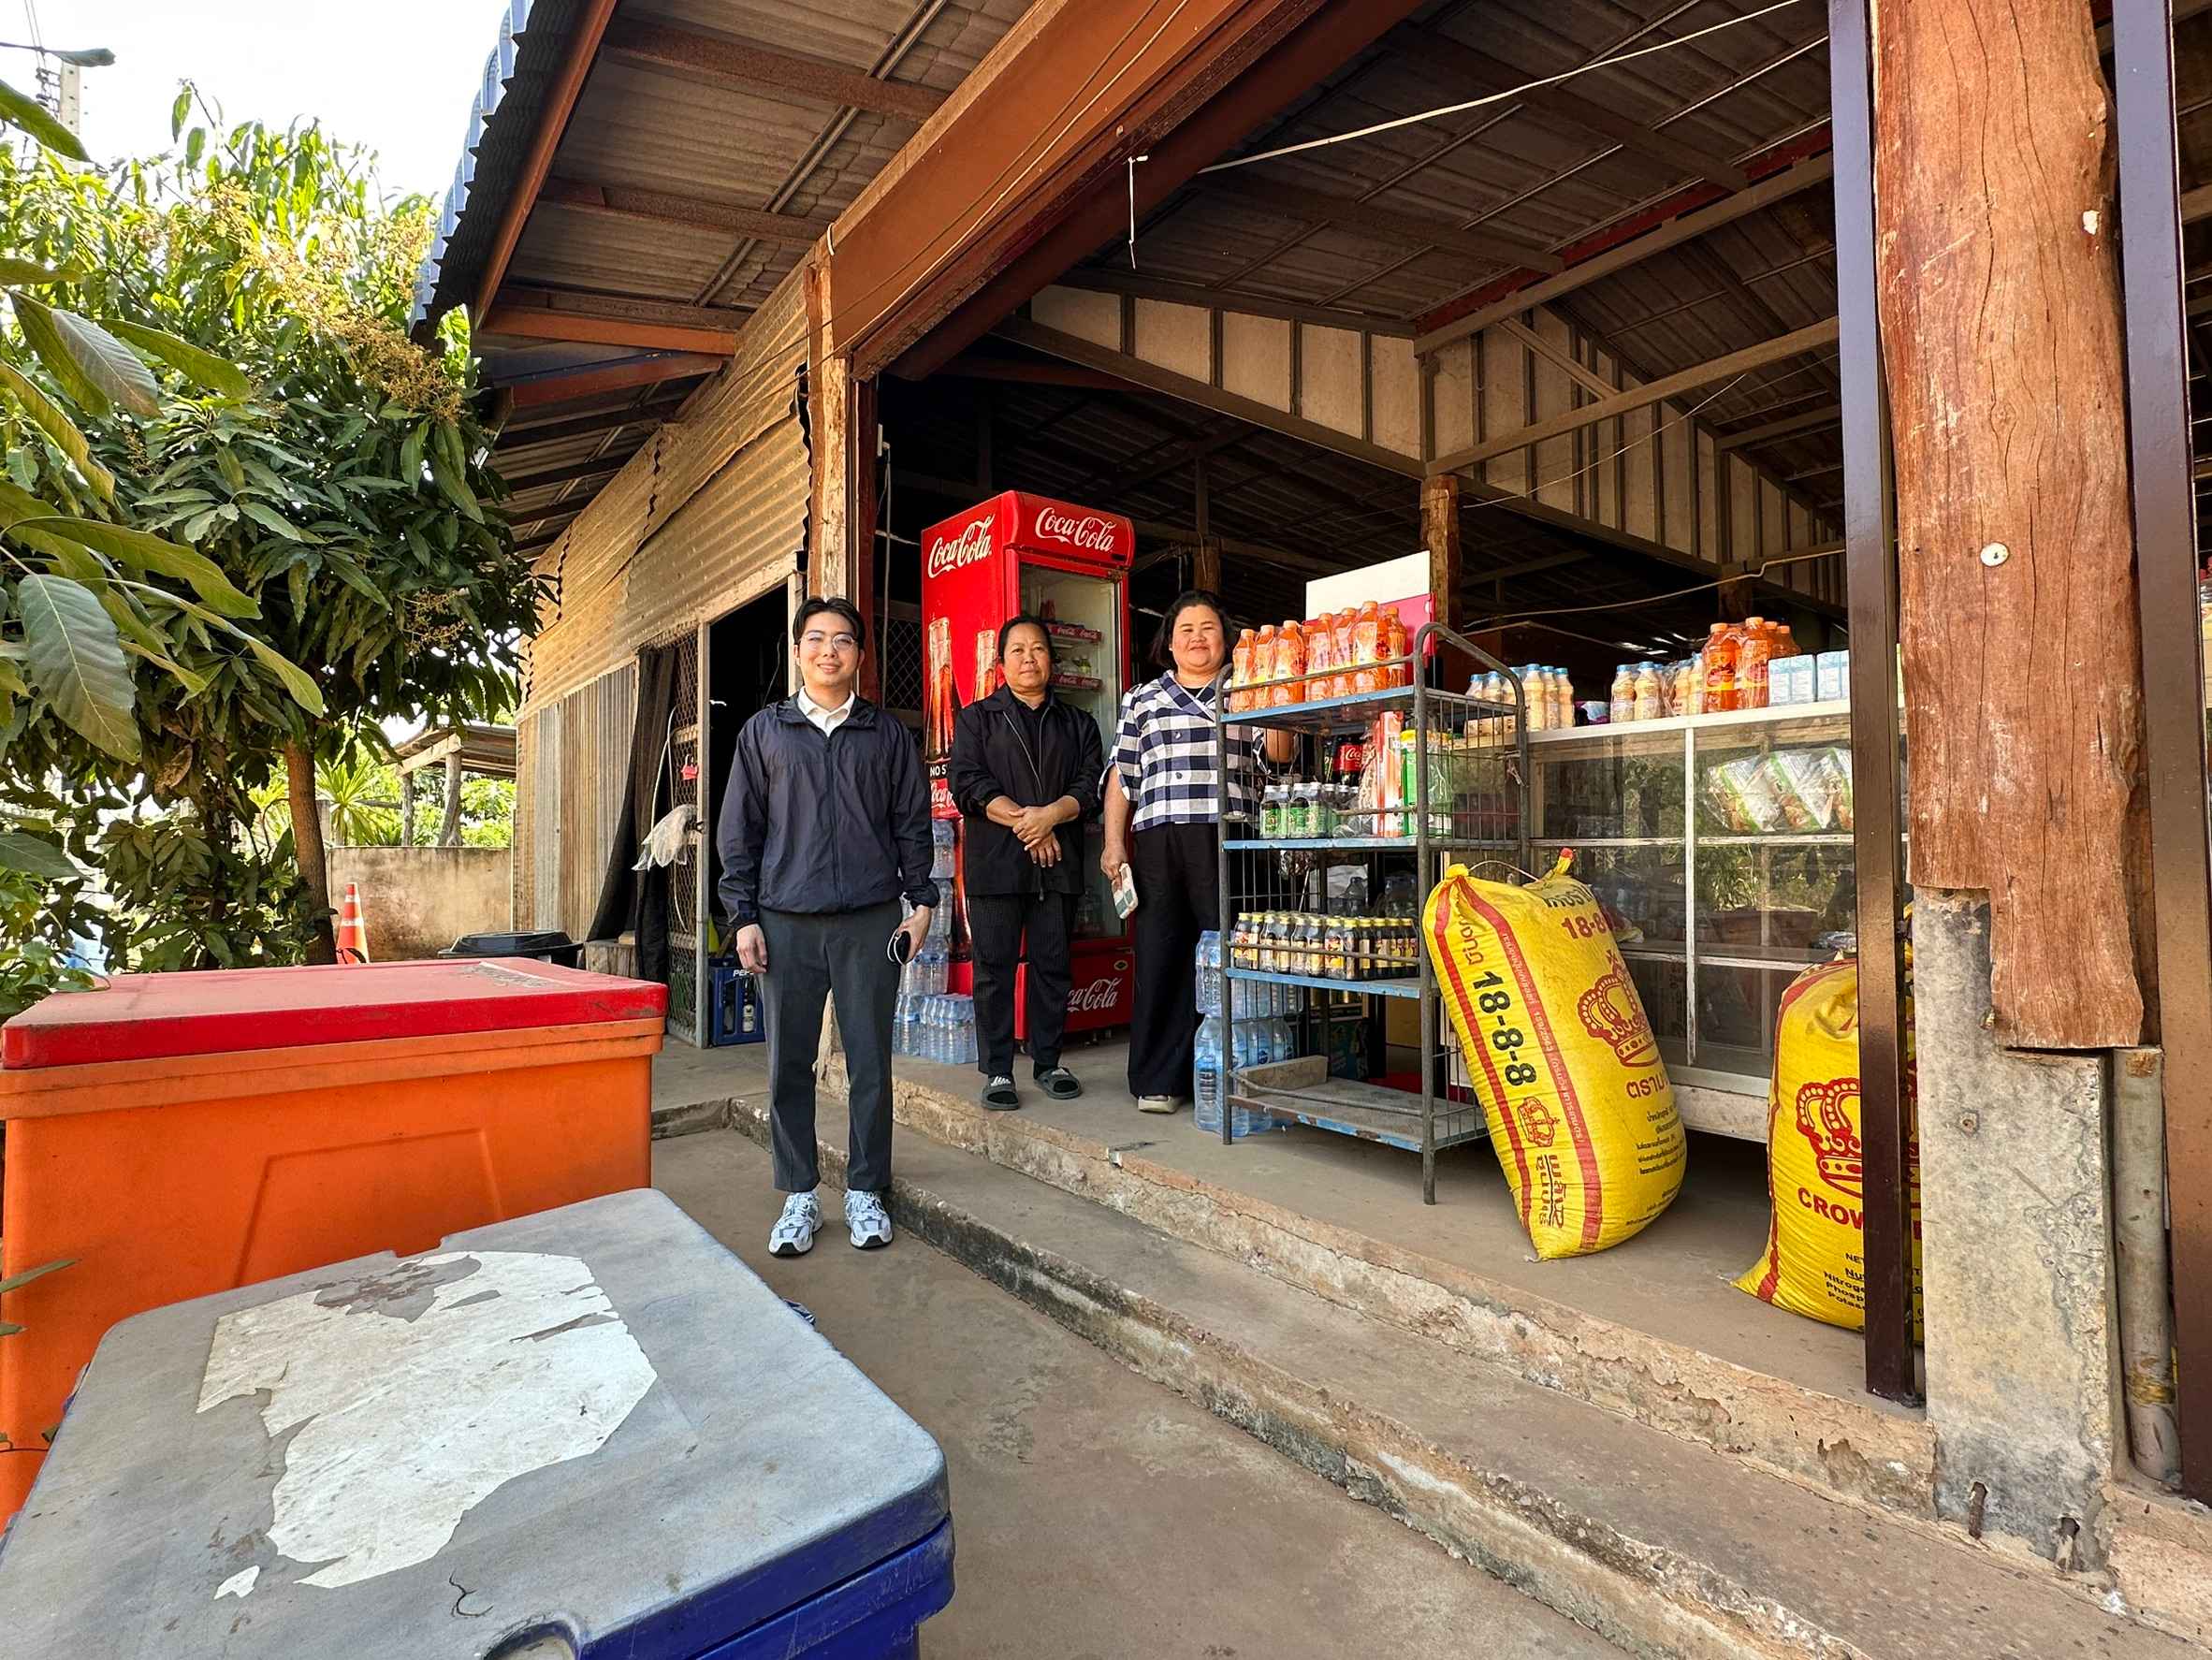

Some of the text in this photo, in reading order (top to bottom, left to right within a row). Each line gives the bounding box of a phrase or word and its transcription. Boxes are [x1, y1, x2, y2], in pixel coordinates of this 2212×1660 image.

[927, 514, 996, 578] Coca-Cola
[1035, 507, 1117, 552] Coca-Cola
[1561, 912, 1607, 939] 18-8
[1472, 970, 1536, 1086] 18-8-8
